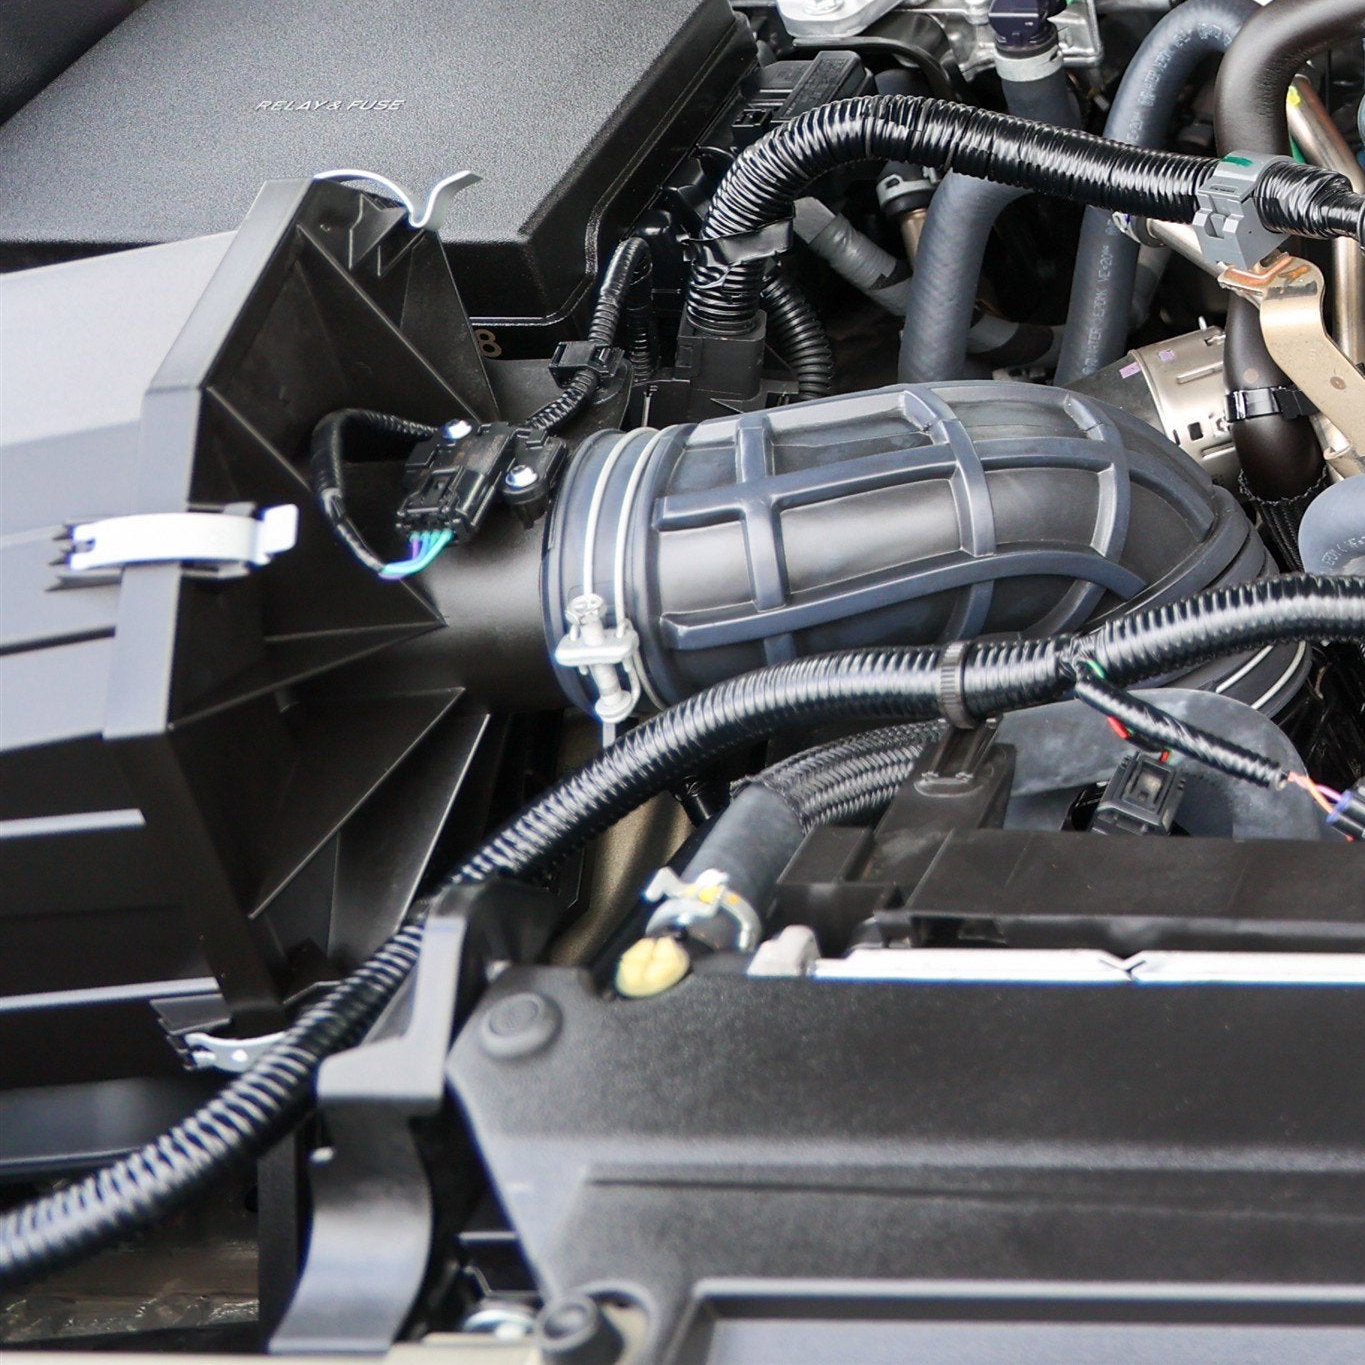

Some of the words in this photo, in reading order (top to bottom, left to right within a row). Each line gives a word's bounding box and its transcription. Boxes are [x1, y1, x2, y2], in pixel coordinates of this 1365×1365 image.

[254, 100, 329, 111] RELAY
[326, 100, 342, 110] &
[347, 99, 407, 110] FUSE
[475, 328, 502, 358] 8
